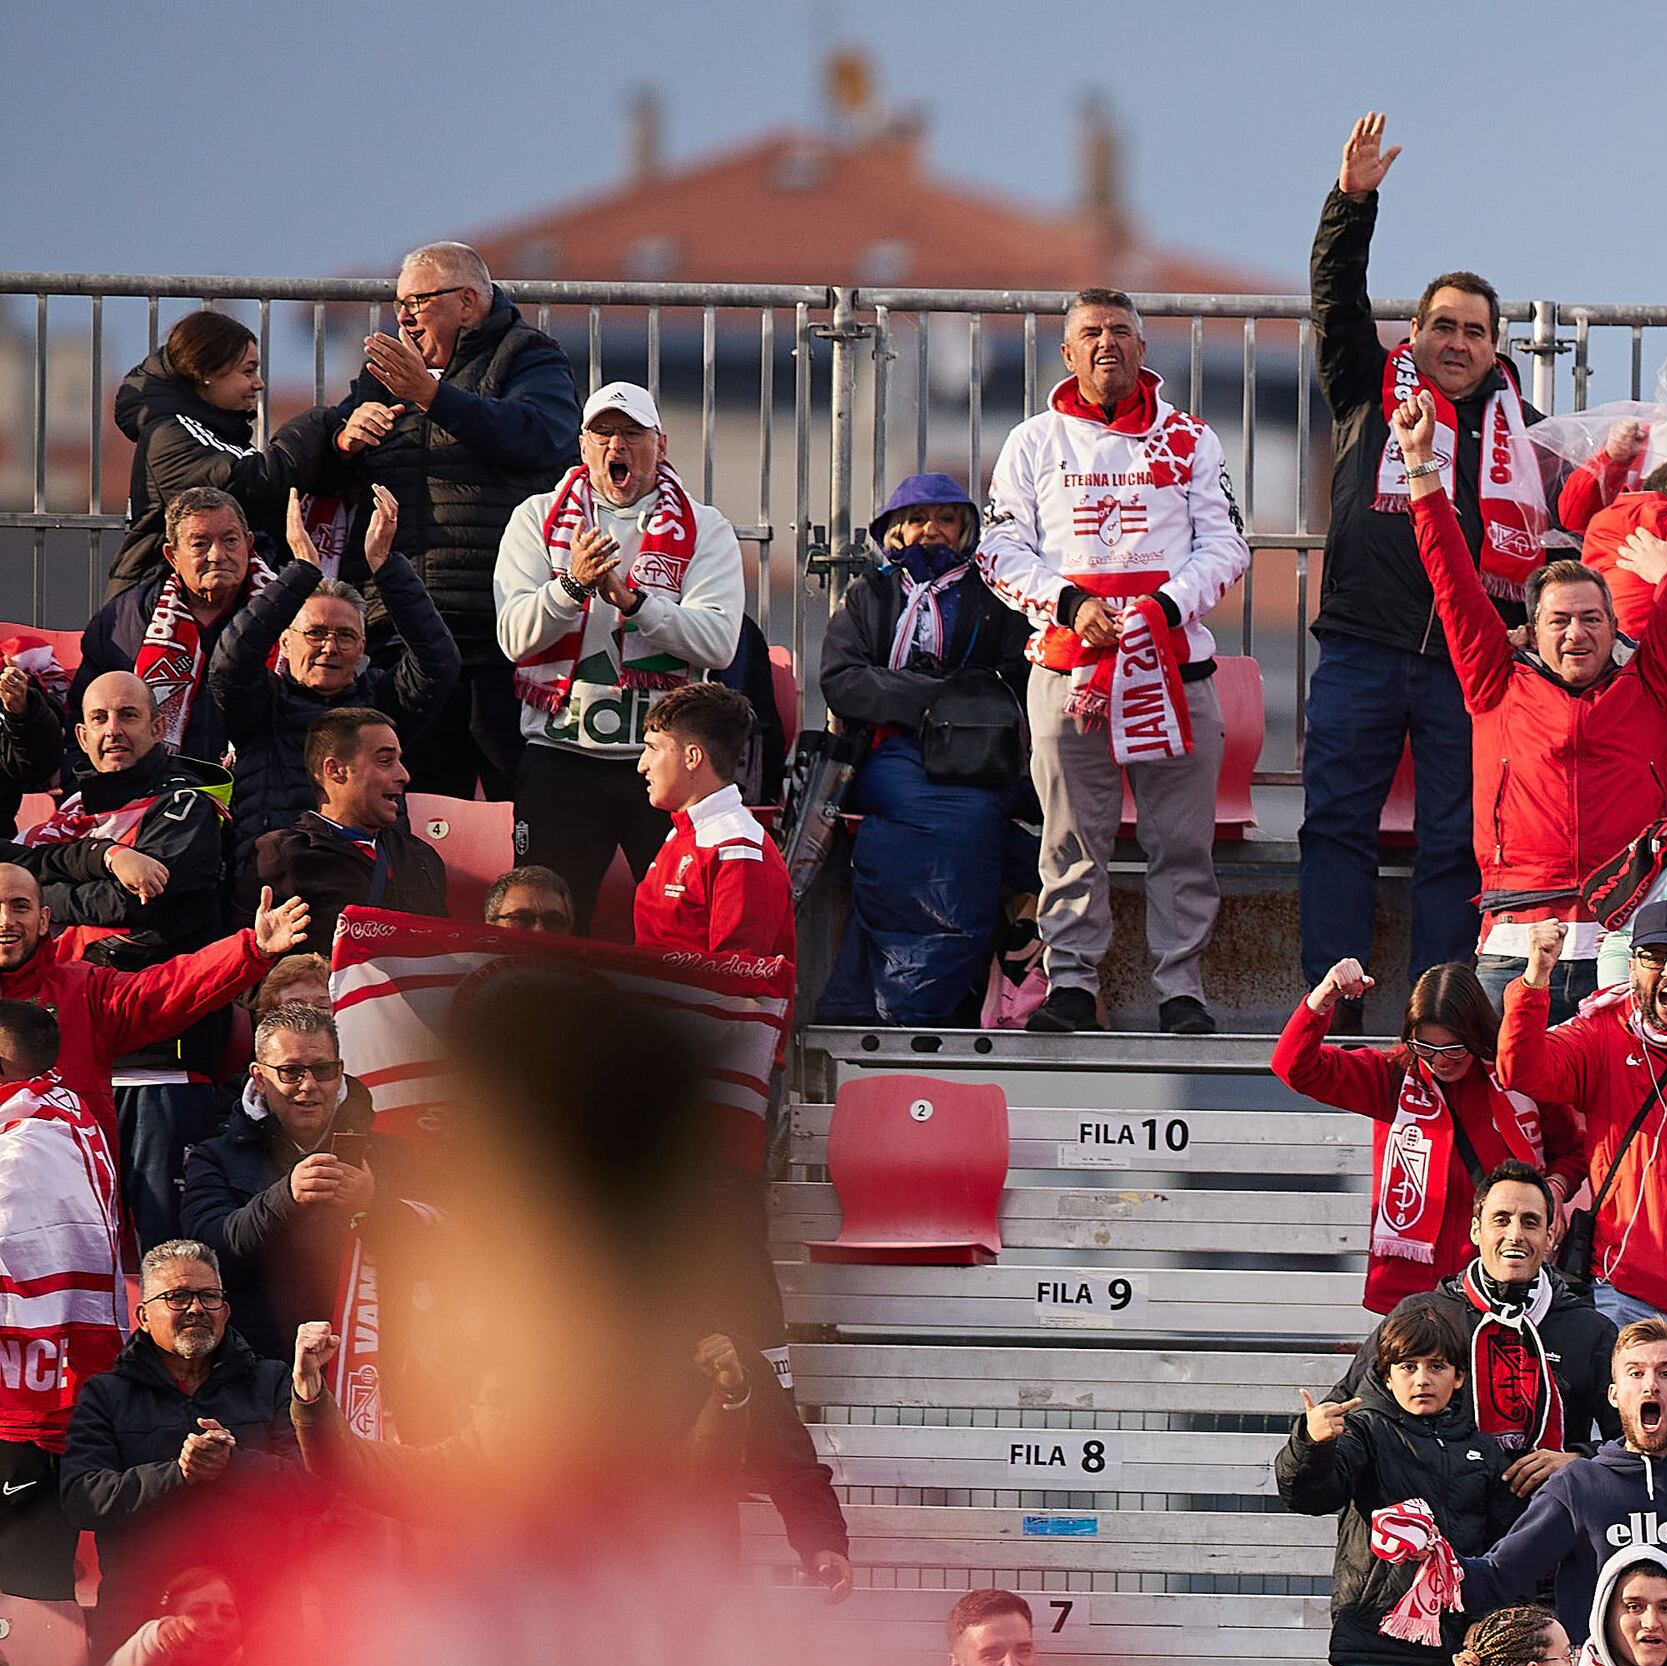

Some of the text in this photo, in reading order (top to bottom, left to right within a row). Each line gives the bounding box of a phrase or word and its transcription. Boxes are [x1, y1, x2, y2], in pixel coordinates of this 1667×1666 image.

[1064, 471, 1155, 488] ETERNA LUCHA
[432, 823, 441, 836] 4
[917, 1104, 926, 1117] 2
[1079, 1118, 1189, 1152] FILA 10
[1037, 1277, 1133, 1311] FILA 9
[1010, 1439, 1107, 1473] FILA 8
[1049, 1600, 1074, 1634] 7
